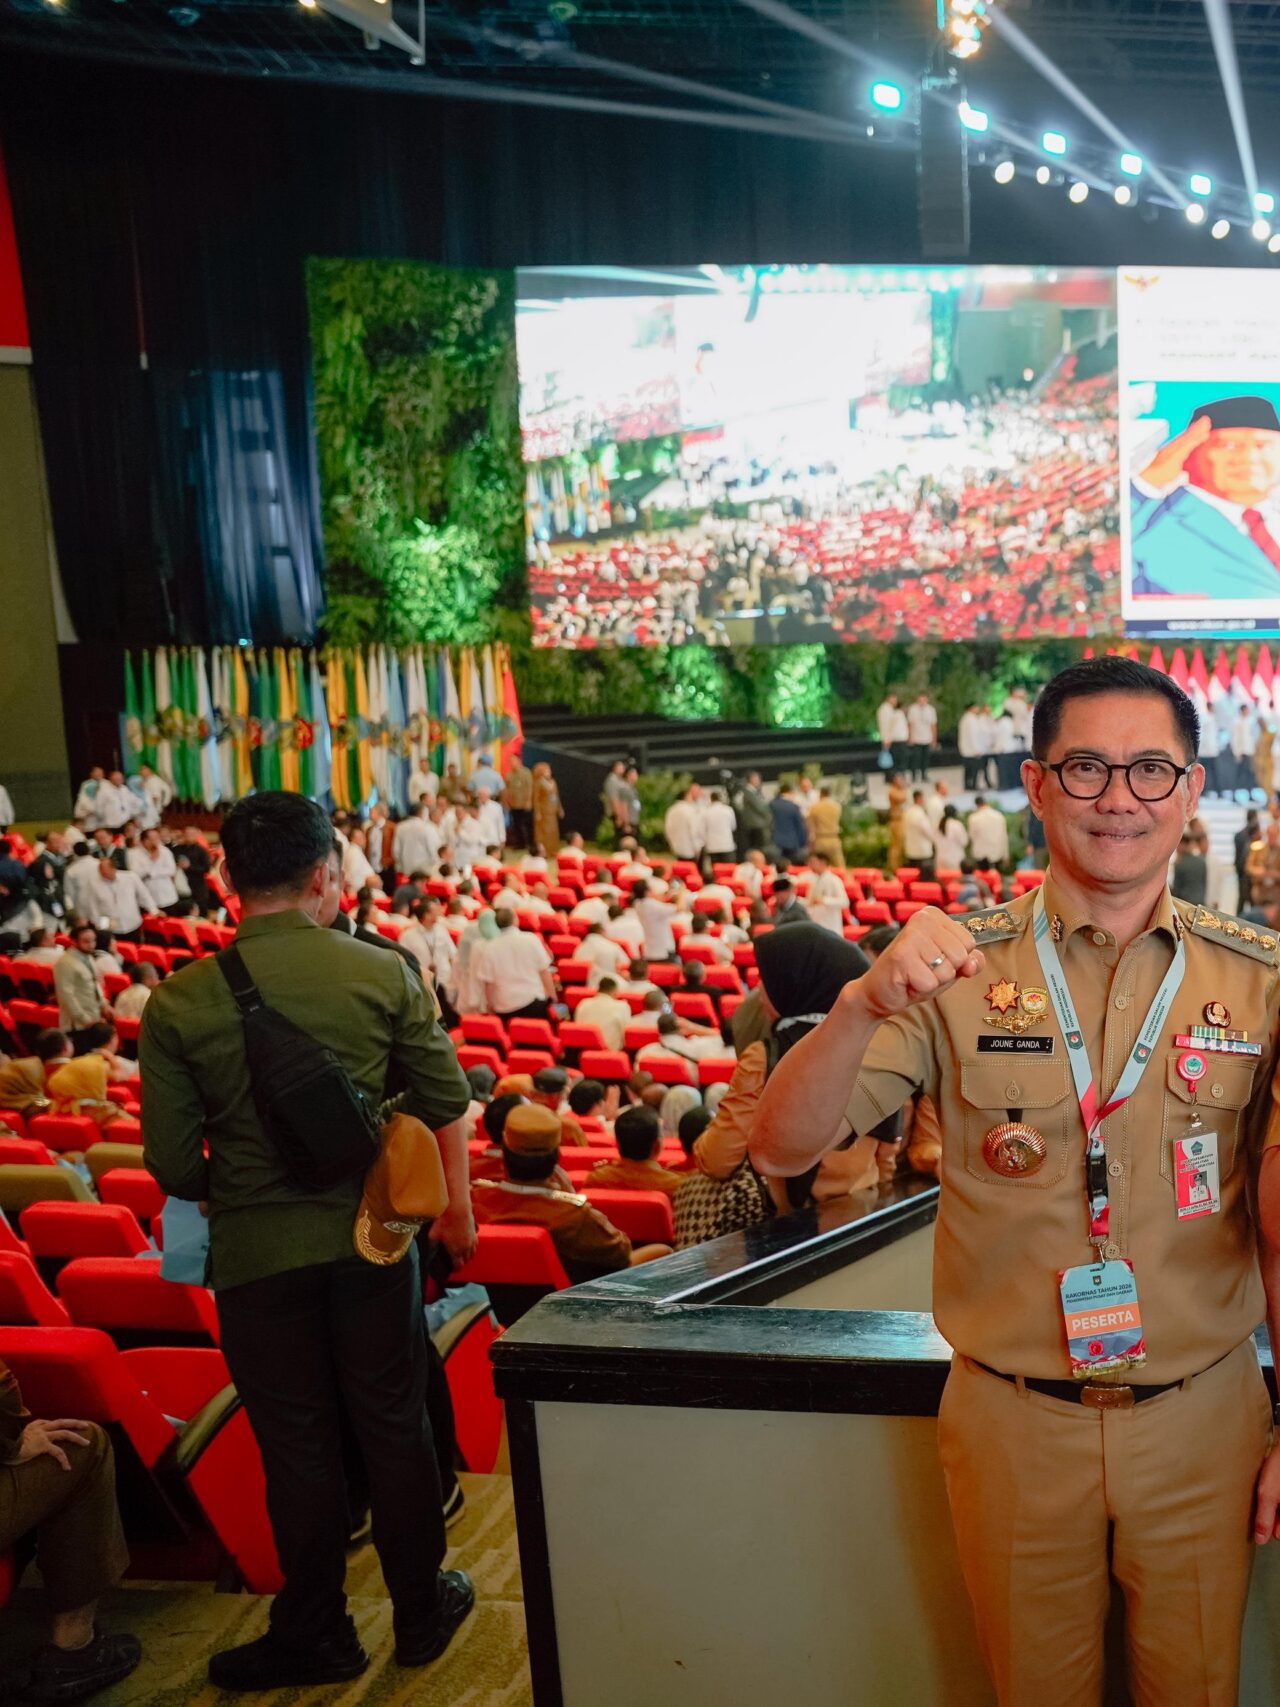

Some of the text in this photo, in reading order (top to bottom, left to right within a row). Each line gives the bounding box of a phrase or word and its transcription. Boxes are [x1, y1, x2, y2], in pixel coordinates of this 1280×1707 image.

[990, 1039, 1040, 1049] JOUNE GANDA
[1065, 1290, 1097, 1299] RAKORNAS
[1071, 1310, 1134, 1332] PESERTA
